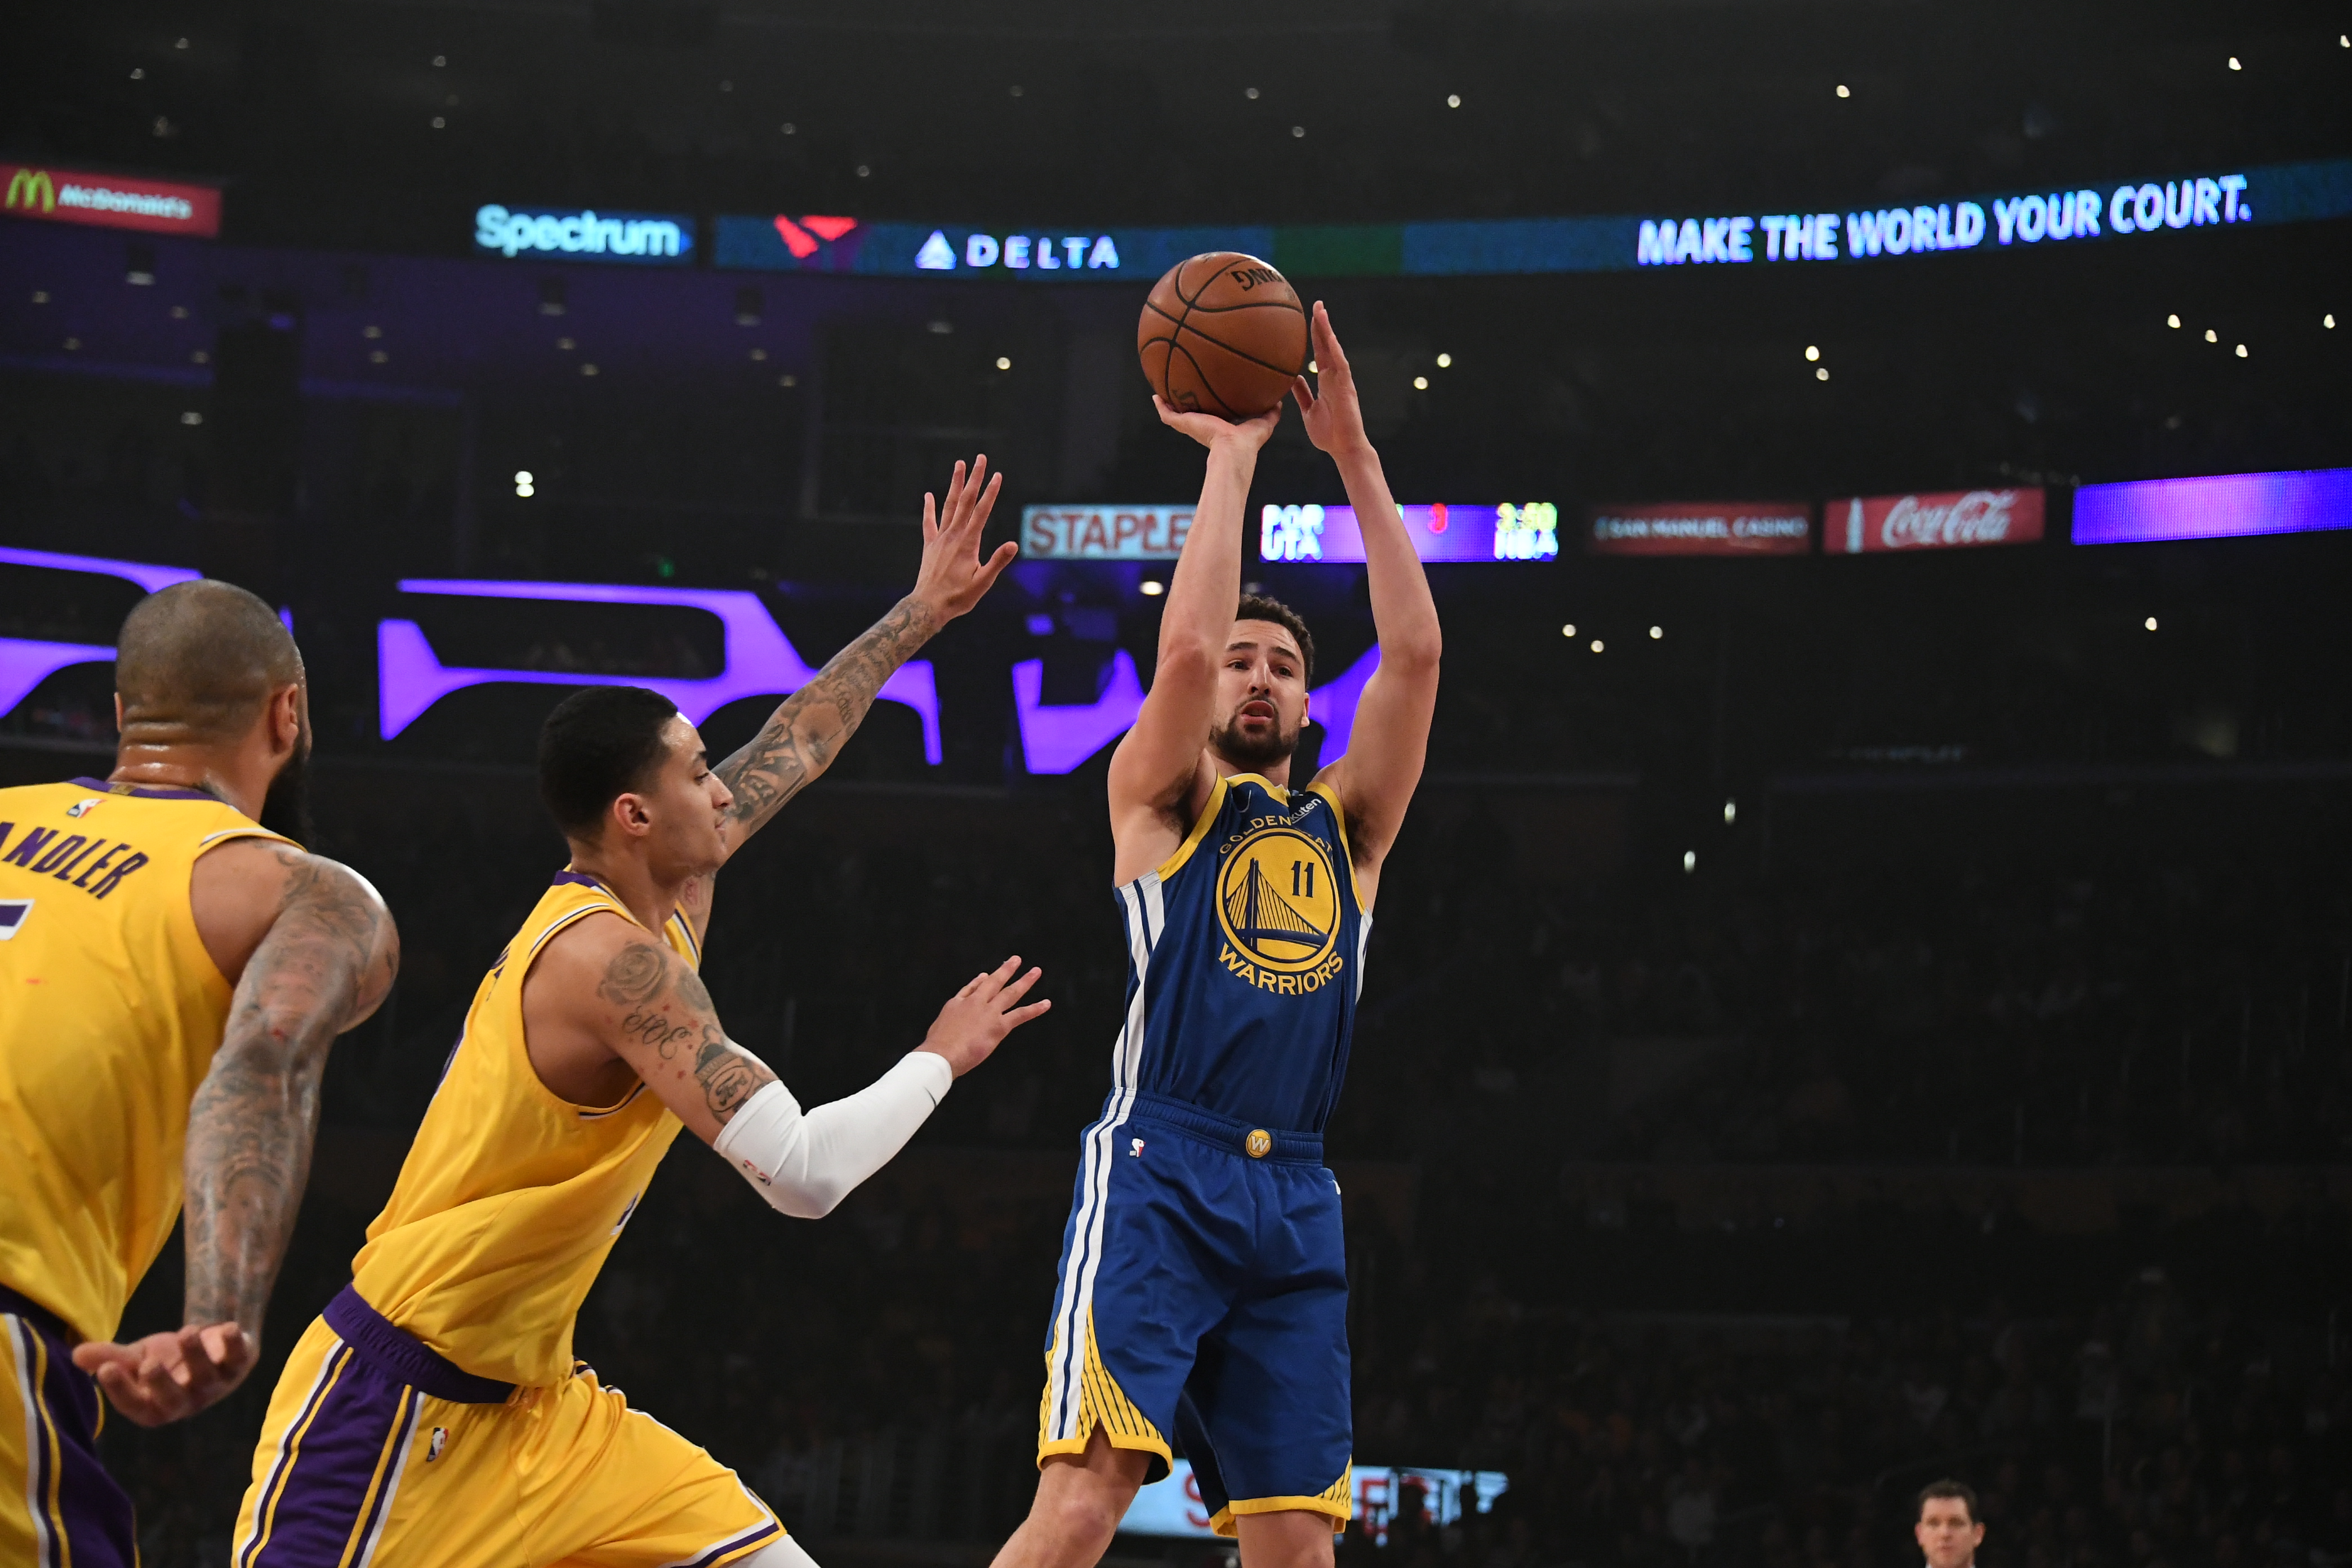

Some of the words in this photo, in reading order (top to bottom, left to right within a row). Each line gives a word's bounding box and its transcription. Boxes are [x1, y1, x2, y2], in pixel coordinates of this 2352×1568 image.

[57, 183, 194, 220] McDonald's
[1637, 216, 1754, 265] MAKE
[1760, 213, 1841, 261] THE
[1846, 201, 1986, 259] WORLD
[1993, 189, 2102, 245] YOUR
[2109, 174, 2252, 234] COURT.
[475, 204, 681, 258] Spectrum
[966, 234, 1120, 269] DELTA
[1029, 513, 1196, 556] STAPLE
[1261, 528, 1324, 560] UTA
[1732, 515, 1809, 538] CASINO
[1290, 798, 1322, 821] kuten
[1219, 815, 1291, 854] GOLDEN
[1290, 860, 1315, 898] 11
[1218, 942, 1343, 995] WARRIORS
[1250, 1135, 1269, 1152] W
